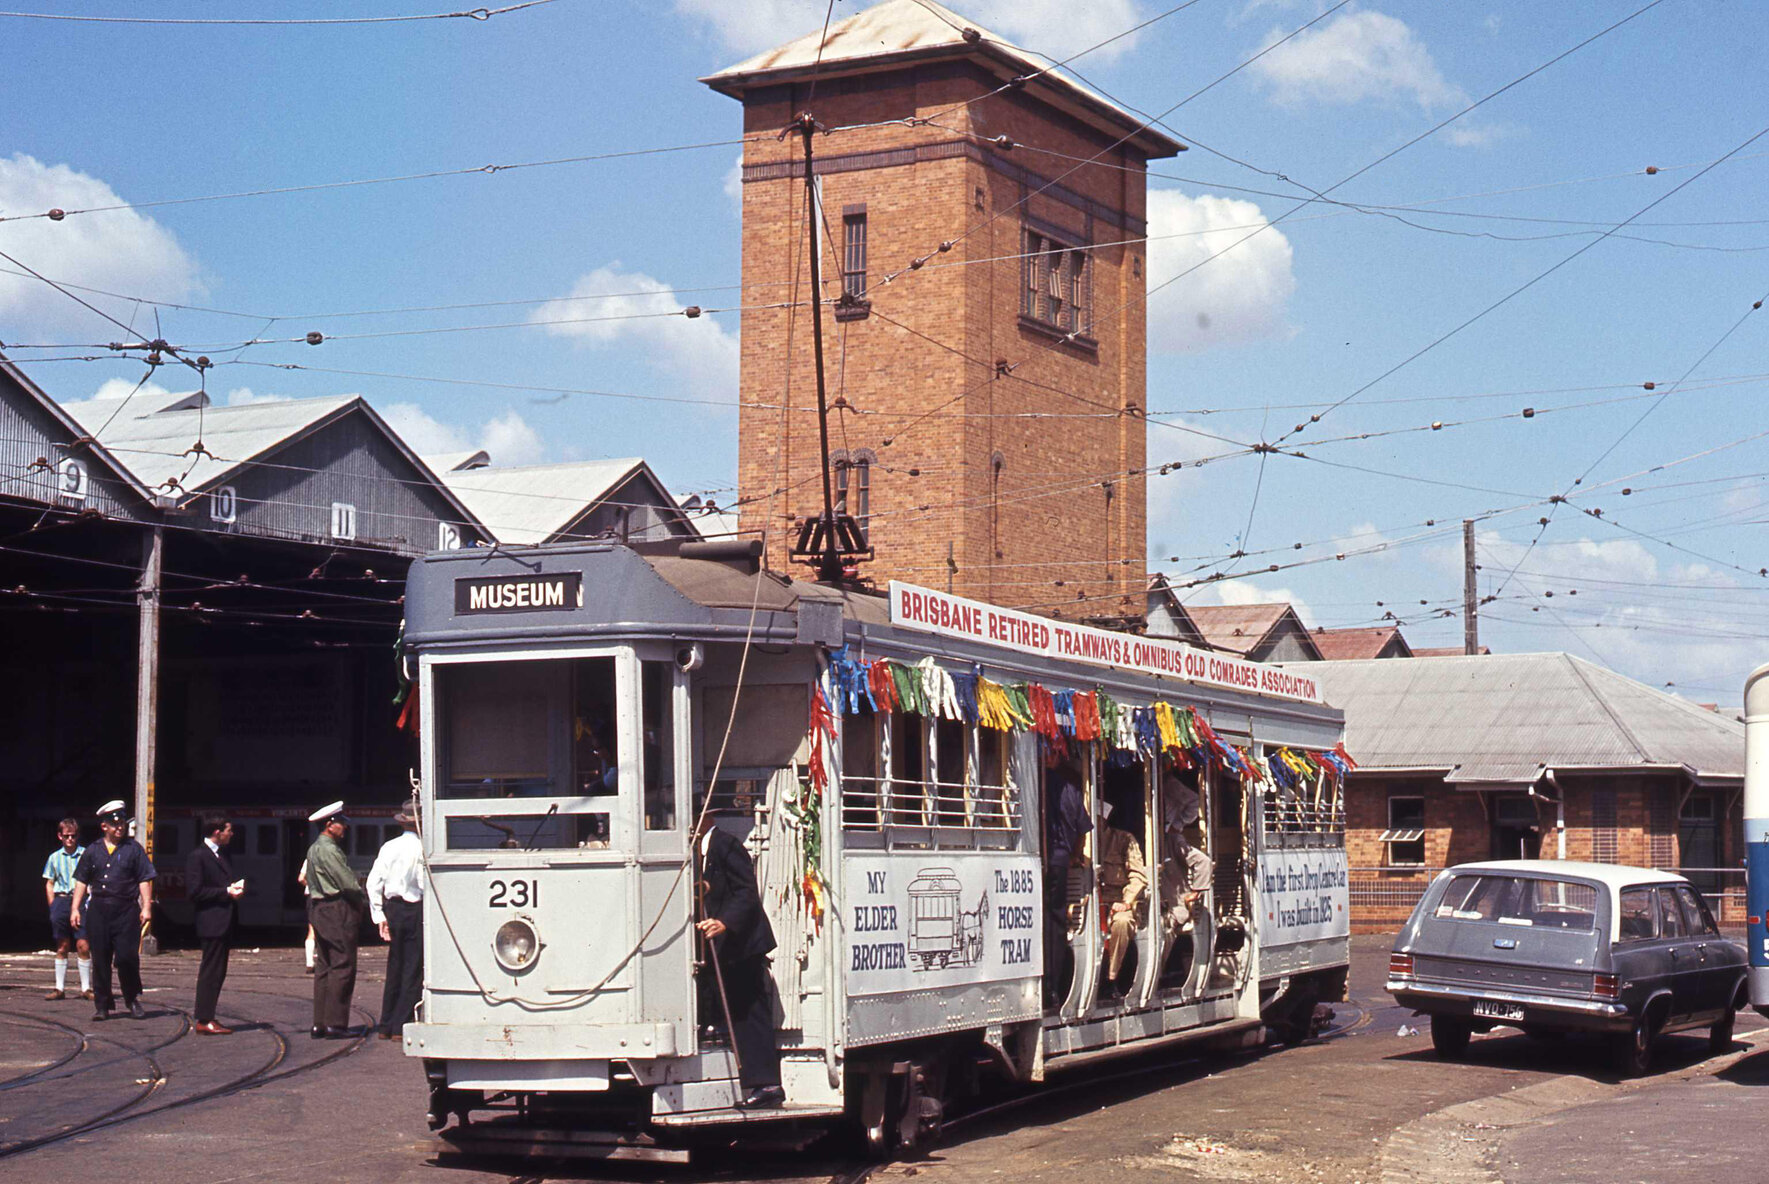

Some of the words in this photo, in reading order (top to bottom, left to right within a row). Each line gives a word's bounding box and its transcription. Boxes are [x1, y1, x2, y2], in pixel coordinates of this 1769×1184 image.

[67, 463, 80, 492] 9
[215, 488, 232, 519] 10
[338, 508, 349, 536] 11
[443, 526, 457, 550] 12
[470, 582, 563, 609] MUSEUM
[902, 589, 982, 636] BRISBANE
[1055, 627, 1121, 664] TRAMWAYS
[1122, 641, 1131, 665] &
[1133, 644, 1182, 674] OMNIBUS
[1184, 653, 1206, 678] OLD
[1209, 658, 1258, 689] COMRADES
[867, 871, 886, 894] MY
[994, 870, 1009, 892] The
[1010, 870, 1033, 893] 1885
[1266, 874, 1276, 893] am
[1276, 868, 1287, 892] the
[1288, 864, 1303, 892] first
[489, 879, 538, 908] 231
[854, 905, 898, 931] ELDER
[998, 906, 1033, 929] HORSE
[1281, 909, 1295, 928] was
[1296, 898, 1312, 926] built
[851, 943, 906, 971] BROTHER
[1001, 938, 1031, 965] TRAM
